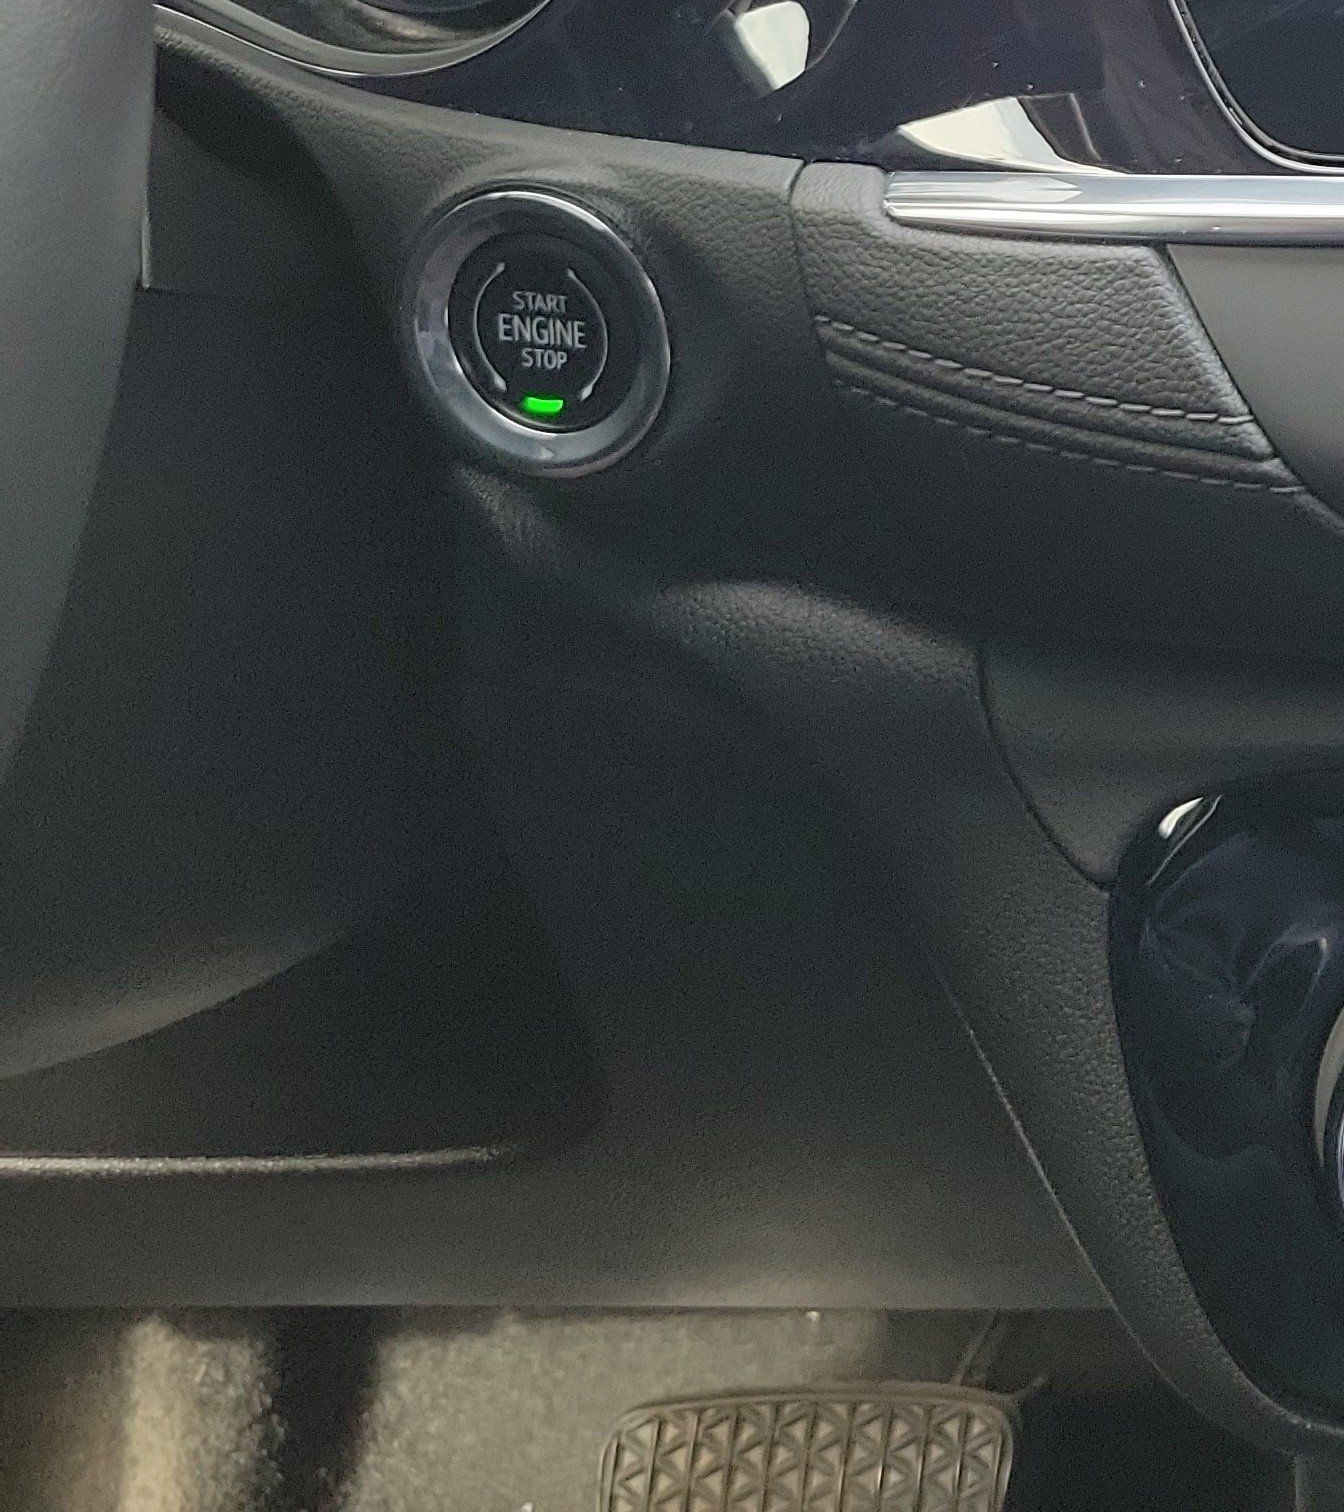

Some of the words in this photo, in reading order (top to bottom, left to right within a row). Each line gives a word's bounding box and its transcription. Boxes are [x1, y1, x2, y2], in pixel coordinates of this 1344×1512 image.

[512, 291, 566, 313] START
[498, 313, 586, 349] ENGINE
[521, 347, 567, 370] STOP
